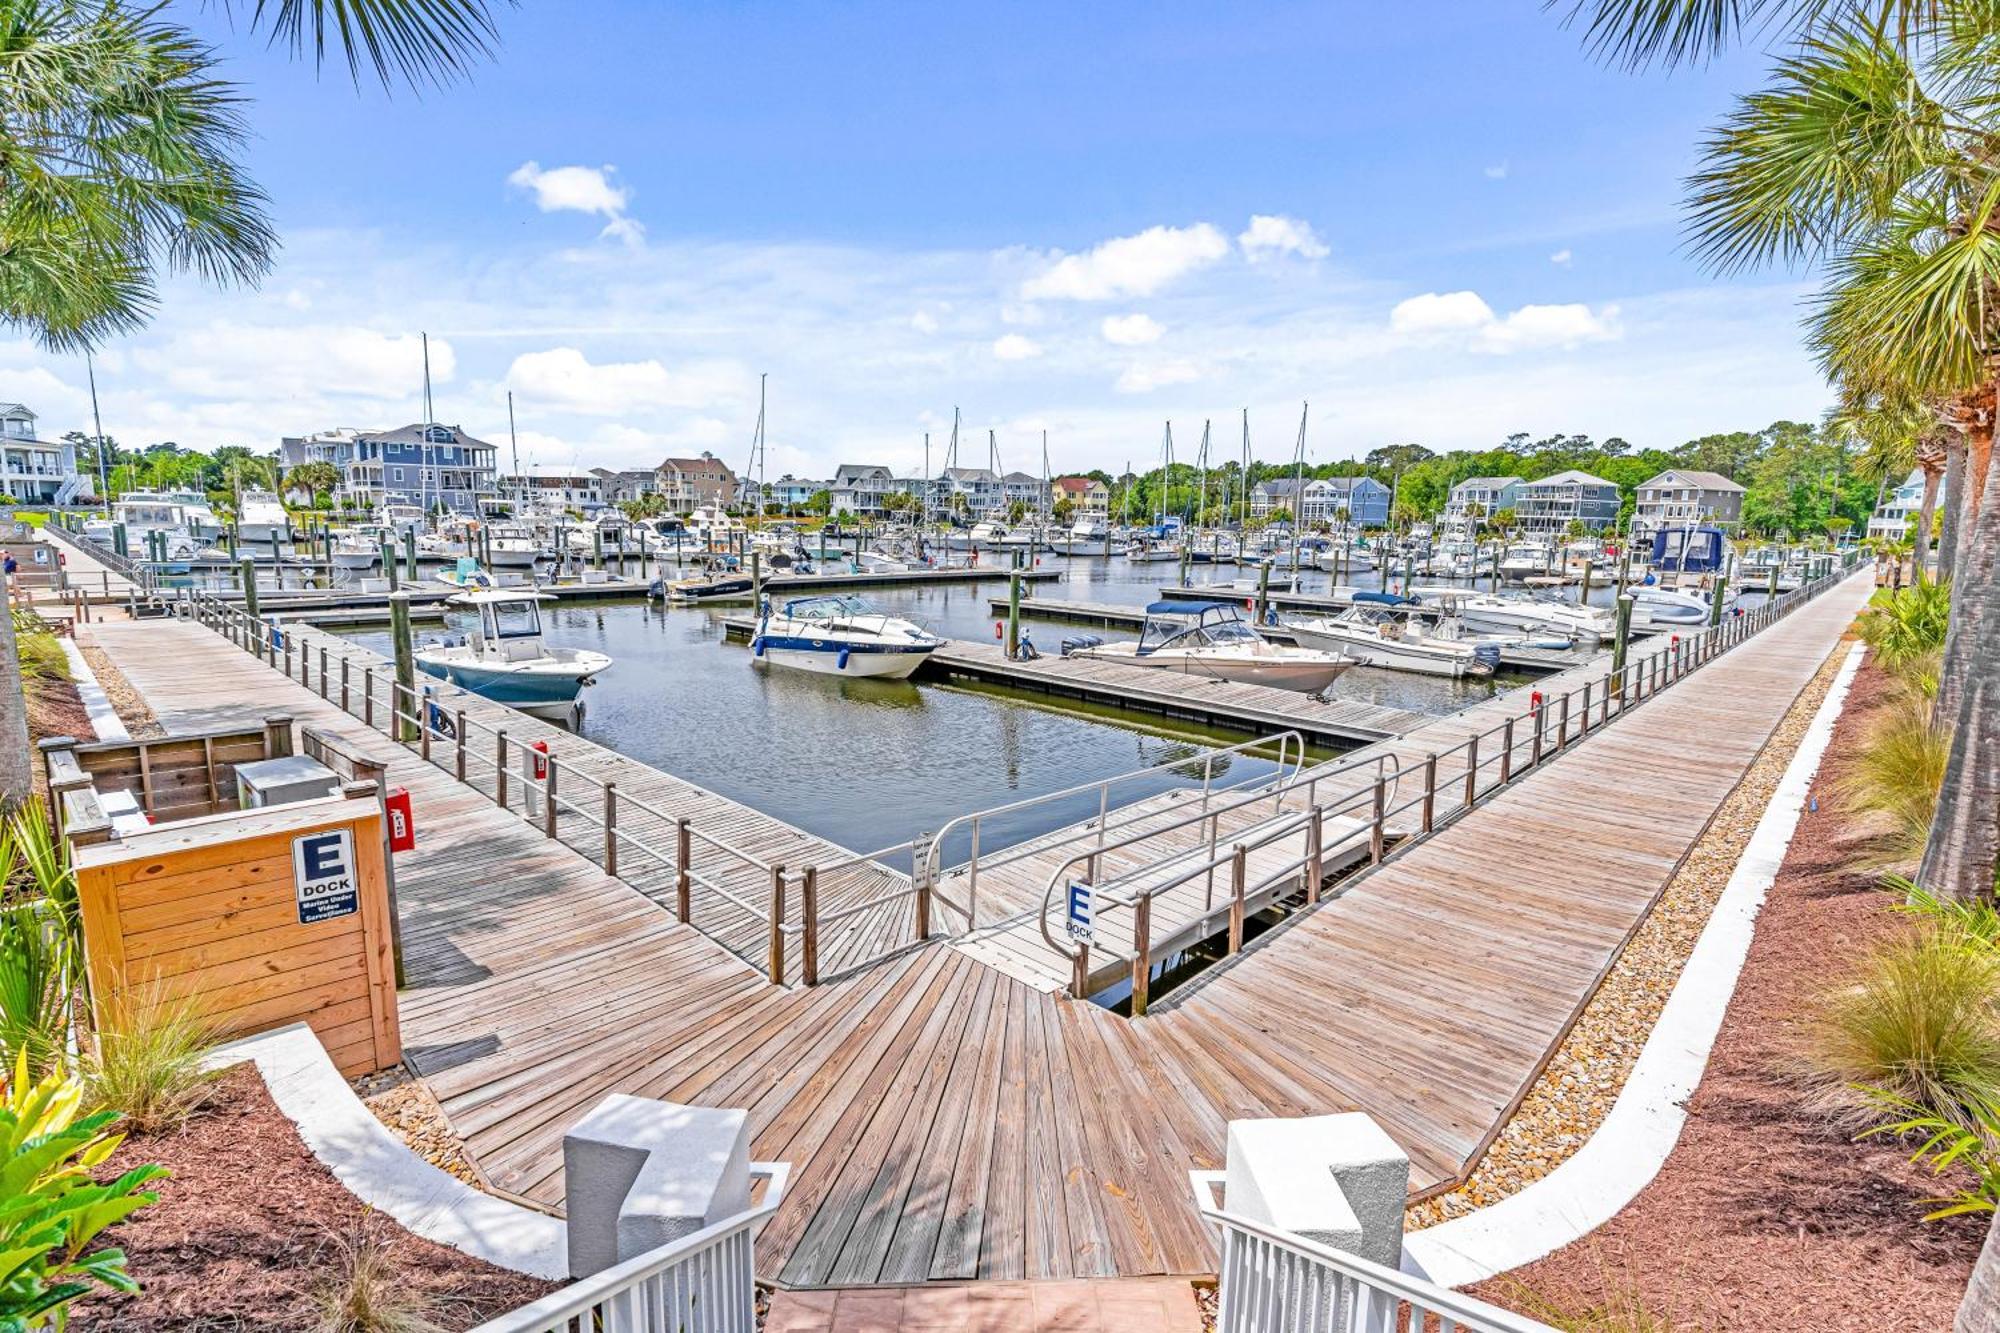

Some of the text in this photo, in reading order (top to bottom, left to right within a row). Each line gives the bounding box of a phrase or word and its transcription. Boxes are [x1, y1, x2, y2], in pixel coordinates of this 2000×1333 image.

[302, 834, 345, 881] E
[303, 879, 350, 897] DOCK
[1070, 885, 1090, 925] E
[1066, 921, 1092, 940] DOCK
